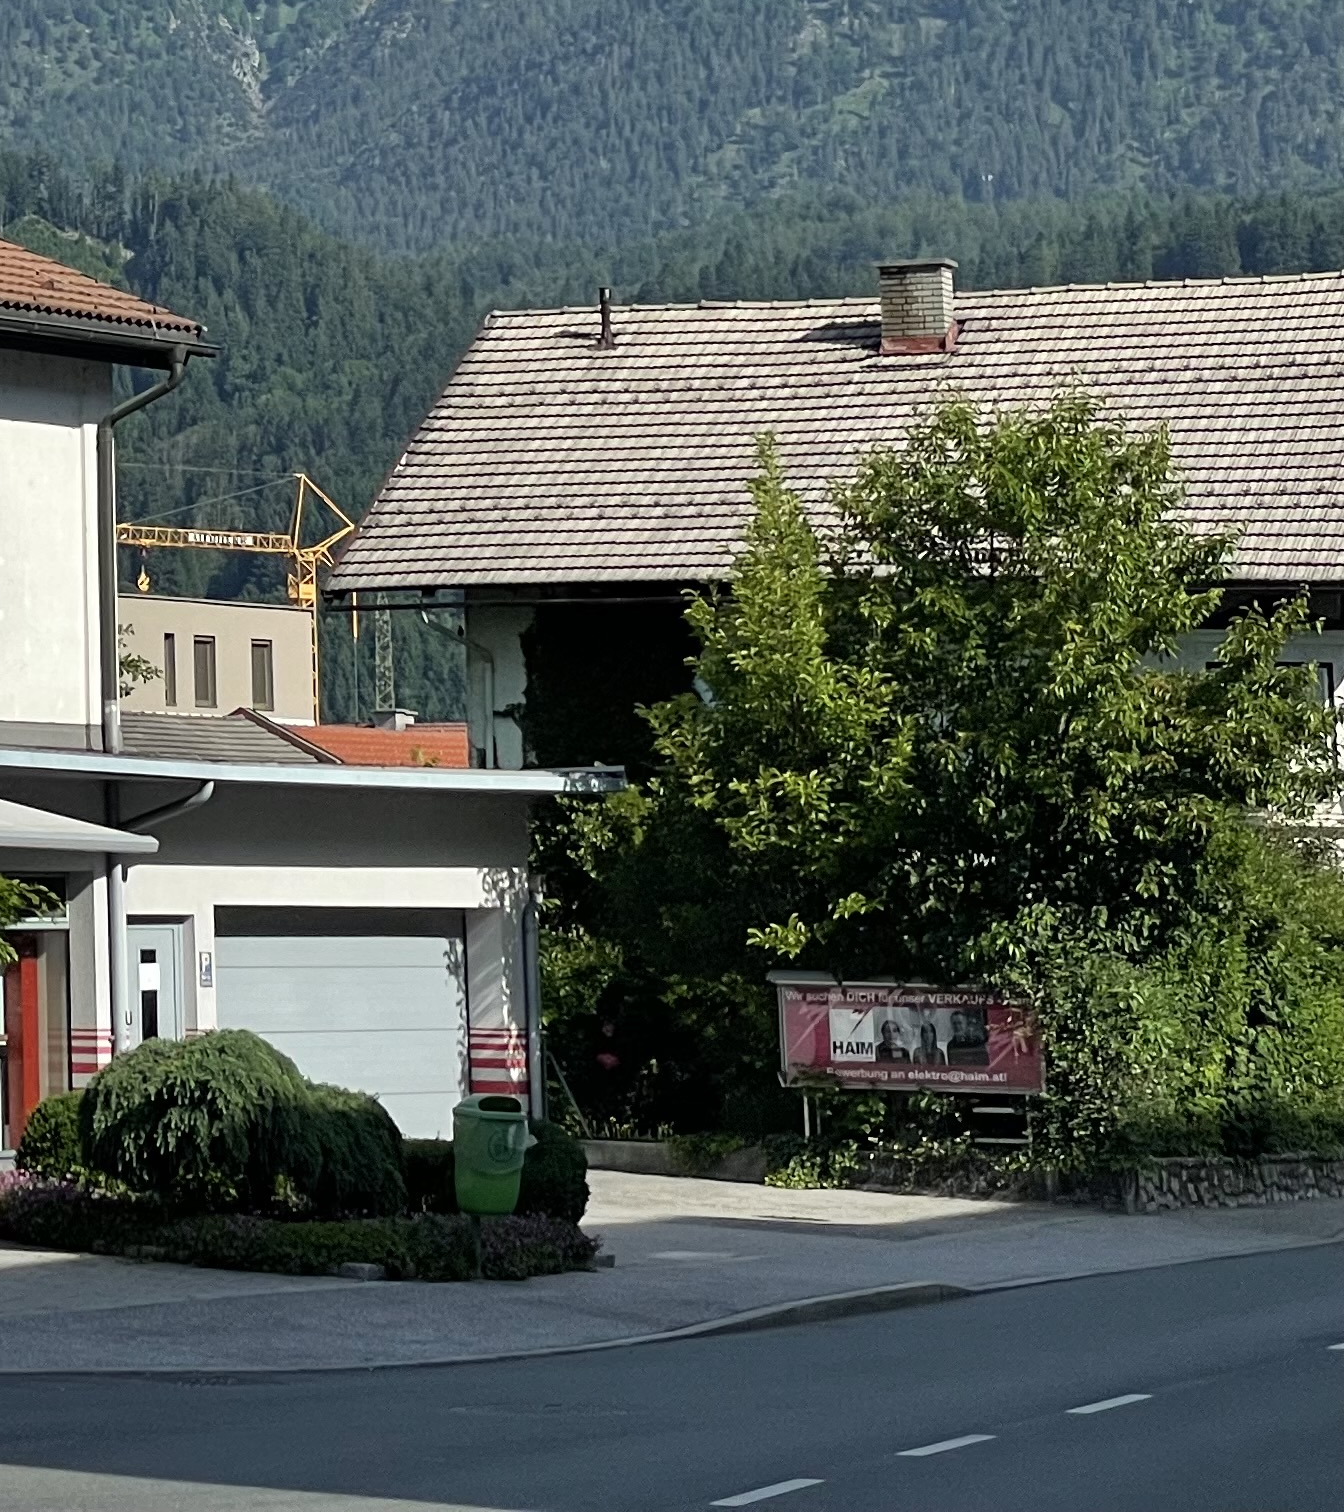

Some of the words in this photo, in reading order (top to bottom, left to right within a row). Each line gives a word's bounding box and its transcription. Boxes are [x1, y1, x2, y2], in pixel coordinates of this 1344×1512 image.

[785, 990, 806, 1002] Wir
[806, 991, 845, 1003] suchen
[846, 992, 875, 1003] DICH
[832, 1041, 875, 1056] HAIM
[891, 1070, 906, 1080] an
